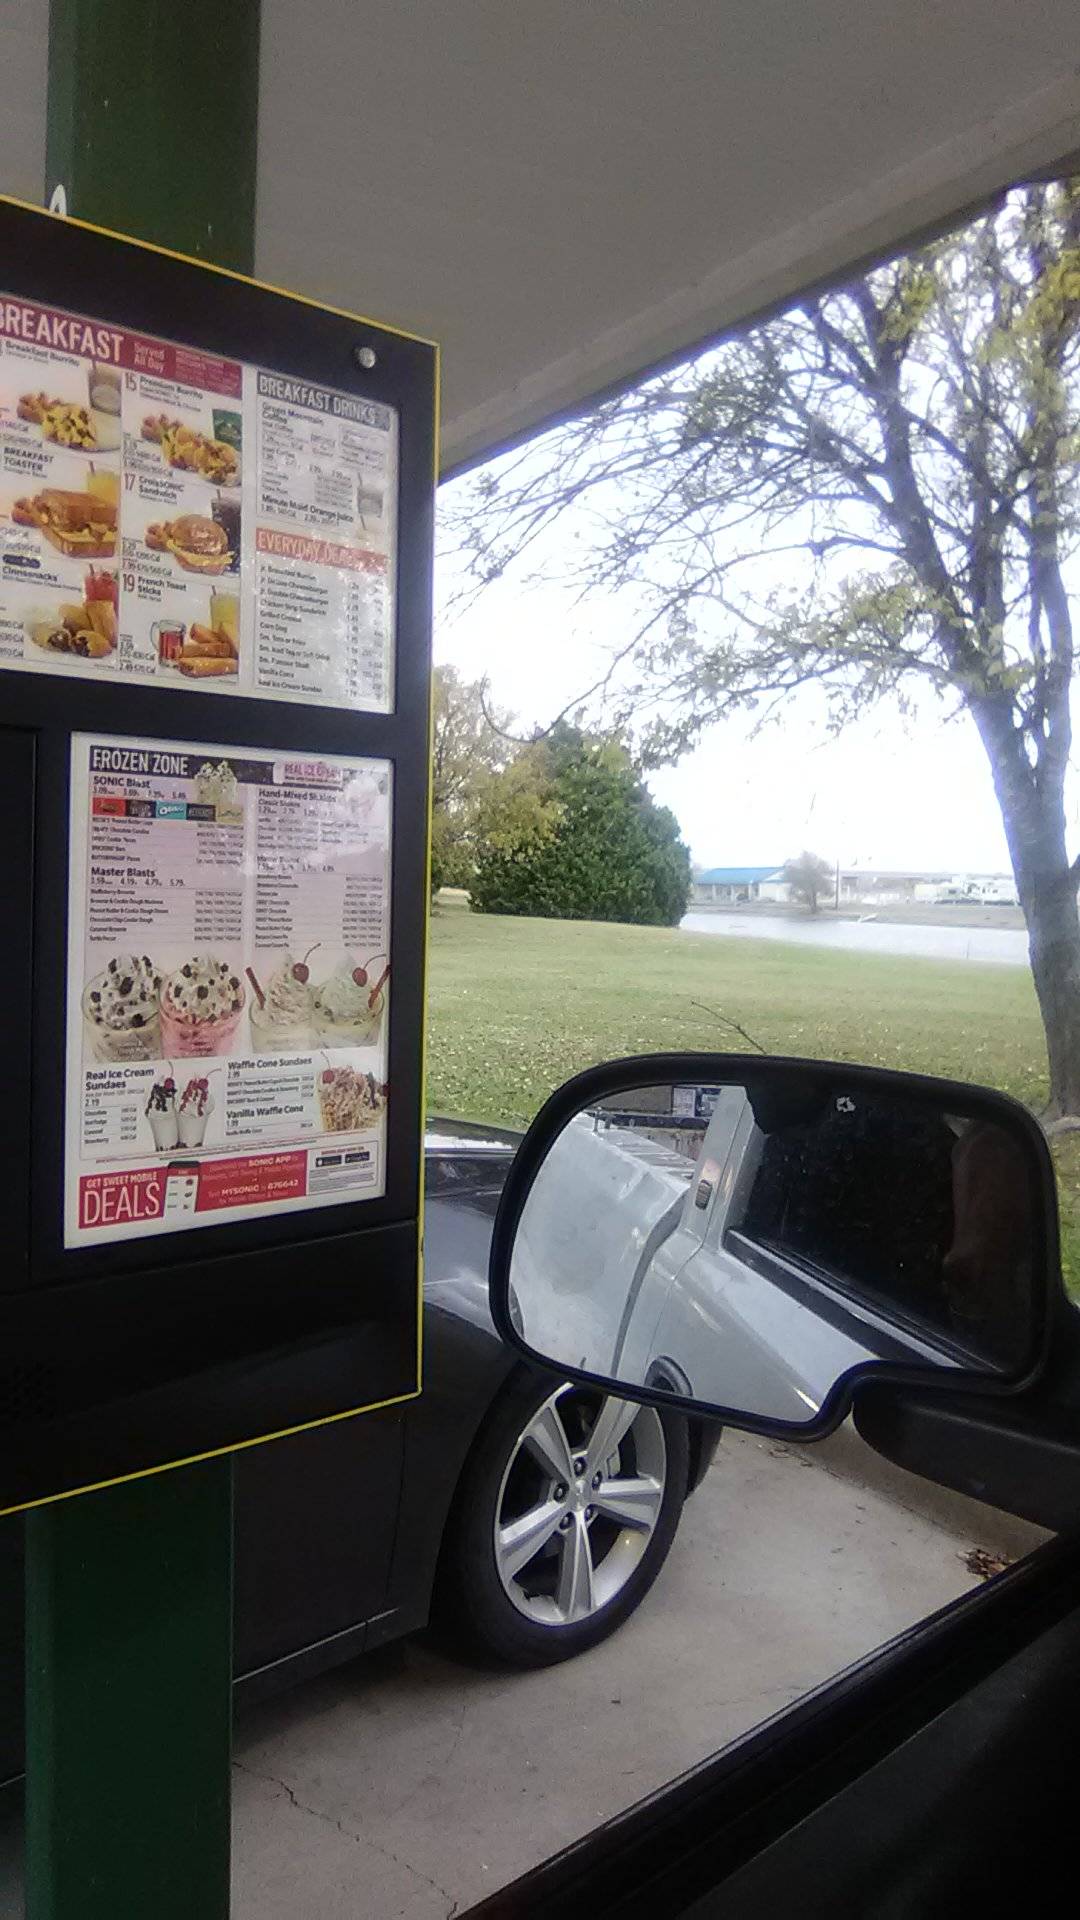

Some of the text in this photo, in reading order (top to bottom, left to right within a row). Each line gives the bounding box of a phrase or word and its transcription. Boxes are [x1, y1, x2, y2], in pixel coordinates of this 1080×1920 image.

[125, 372, 137, 392] 15
[140, 376, 175, 392] Premium
[176, 386, 204, 400] Burrito
[259, 375, 376, 424] BREAKFAST DRINKS
[4, 447, 54, 463] BREAKFAST
[4, 456, 43, 471] TOASTER
[125, 473, 136, 491] 17
[139, 485, 178, 499] Sandwich
[262, 494, 289, 508] Minute
[290, 500, 309, 512] Maid
[310, 505, 337, 519] Orange
[257, 531, 320, 561] EVERYDAY
[123, 573, 136, 593] 19
[138, 576, 187, 592] French Toast
[138, 585, 161, 597] Sticks
[93, 749, 189, 775] FROZEN ZONE
[284, 763, 303, 776] REAL
[93, 775, 152, 789] SONIC Blast
[258, 788, 308, 801] Hand-Mixed
[91, 867, 156, 878] Master Blasts
[228, 1057, 313, 1071] Waffle Cone Sundaes
[86, 1068, 154, 1081] Real Ice Cream
[86, 1080, 127, 1091] Sundaes
[226, 1104, 305, 1120] Vanilla Waffle Cone
[248, 1157, 274, 1168] SONIC
[275, 1155, 292, 1164] APP
[86, 1171, 158, 1189] GET SWEET MOBILE
[221, 1184, 260, 1198] MYSONIC
[84, 1182, 161, 1224] DEALS
